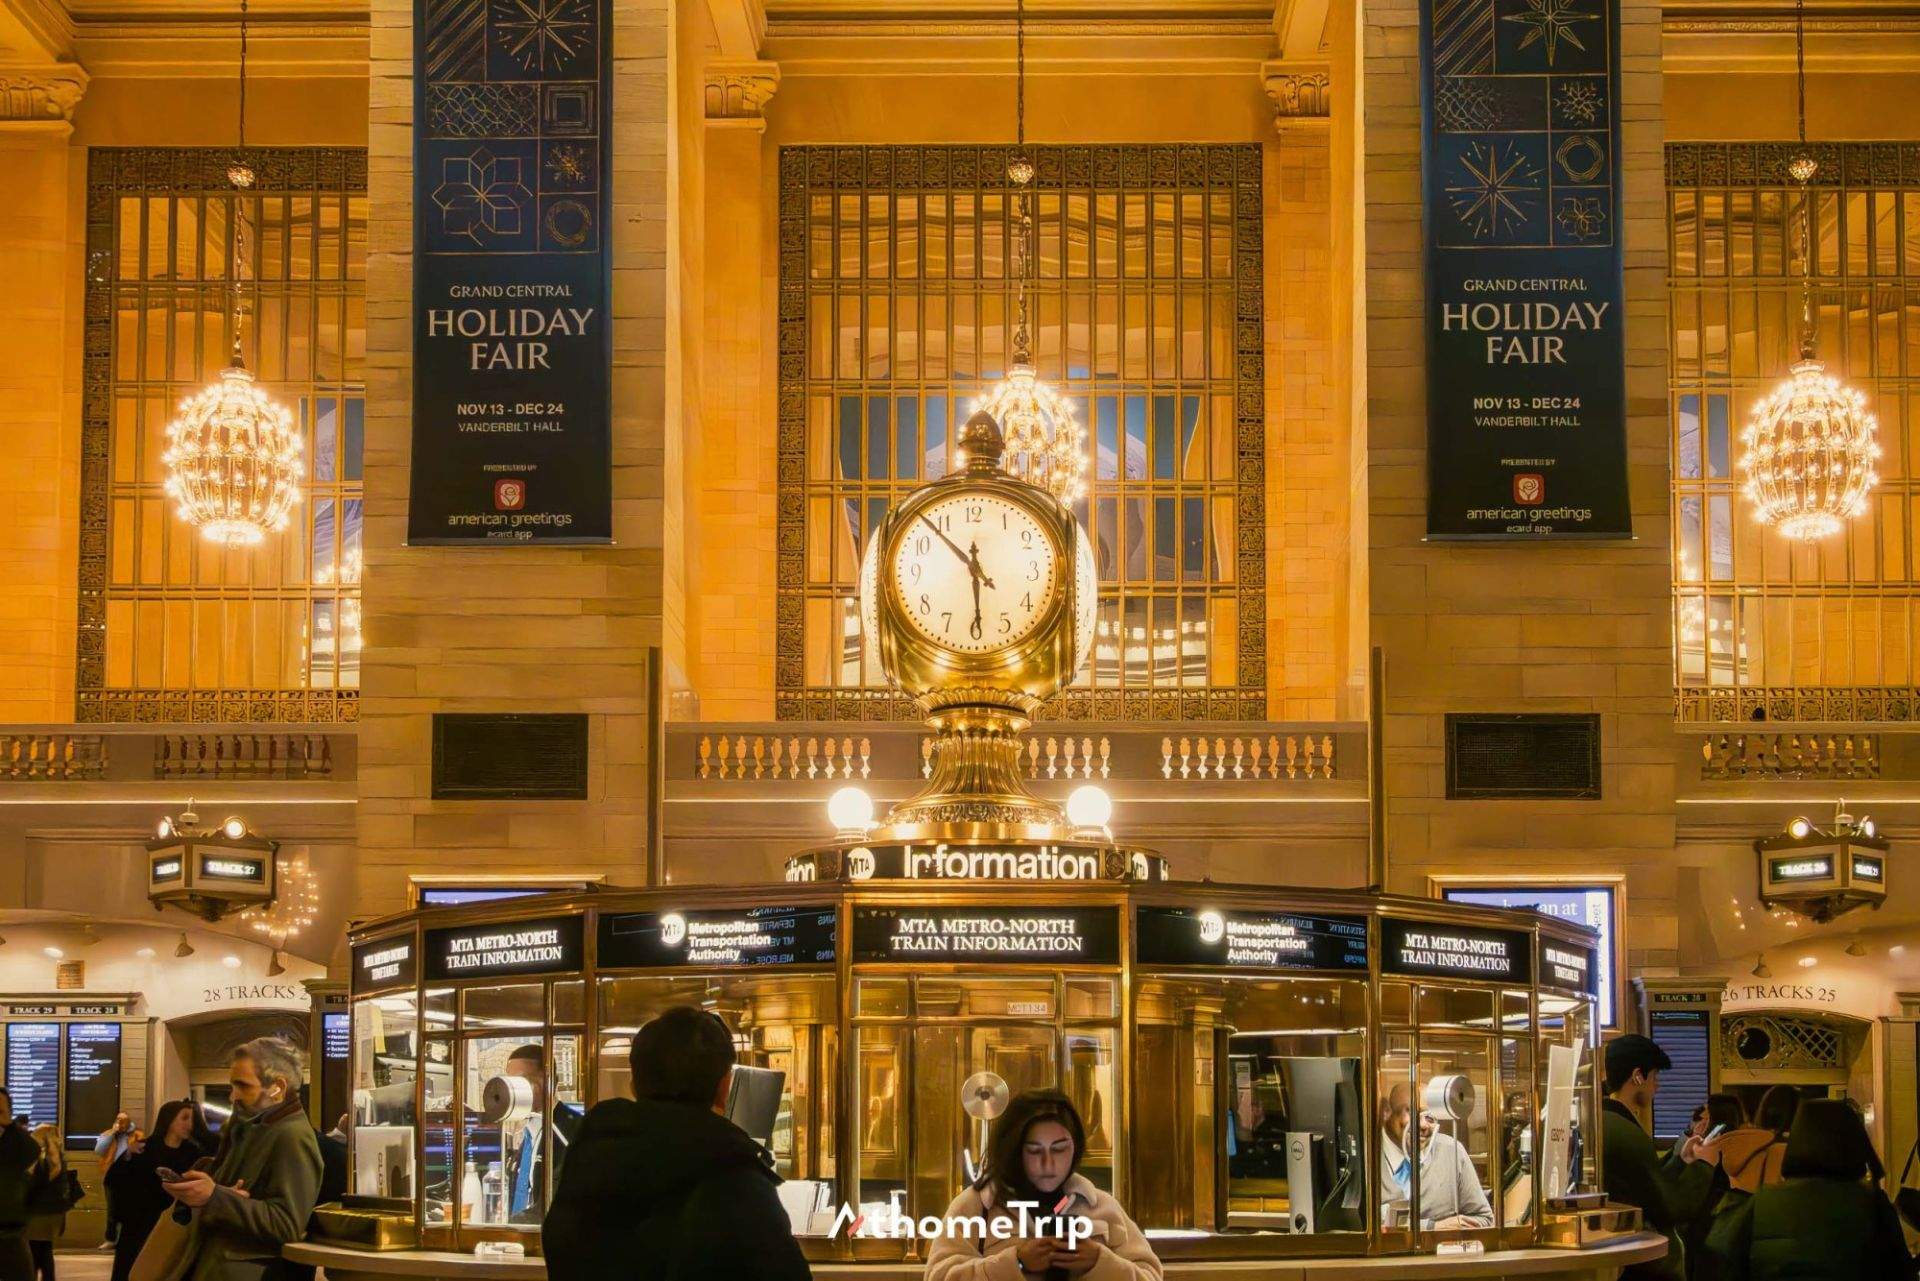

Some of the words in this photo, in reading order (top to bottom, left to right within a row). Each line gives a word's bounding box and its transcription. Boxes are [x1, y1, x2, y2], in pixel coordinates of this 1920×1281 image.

[450, 286, 503, 298] GRAND
[506, 285, 572, 297] CENTRAL
[1464, 279, 1516, 291] GRAND
[1520, 279, 1587, 291] CENTRAL
[427, 308, 594, 337] HOLIDAY
[1442, 302, 1609, 331] HOLIDAY
[470, 342, 551, 370] FAIR
[1486, 336, 1567, 363] FAIR
[457, 404, 487, 415] NOV
[491, 404, 504, 414] 13
[516, 403, 544, 414] DEC
[547, 403, 565, 414] 24
[1474, 398, 1503, 409] NOV
[1507, 398, 1521, 409] 13
[1532, 398, 1561, 409] DEC
[1564, 398, 1580, 408] 24
[458, 422, 530, 432] VANDERBILT
[533, 421, 563, 432] HALL
[1474, 416, 1548, 427] VANDERBILT
[1550, 416, 1580, 426] HALL
[448, 512, 508, 525] american
[511, 511, 572, 527] greetings
[965, 506, 982, 523] 12
[1002, 513, 1007, 530] 1
[1466, 507, 1527, 519] american
[1529, 506, 1592, 521] greetings
[1534, 525, 1552, 535] app
[916, 535, 930, 556] 10
[1021, 530, 1032, 550] 2
[910, 564, 921, 586] 9
[1026, 560, 1039, 581] 3
[919, 593, 931, 615] 8
[1020, 591, 1034, 612] 4
[941, 612, 952, 633] 7
[970, 618, 982, 640] 6
[999, 612, 1011, 634] 5
[904, 844, 1098, 880] Information
[1562, 902, 1579, 915] at
[688, 921, 759, 936] Metropolitan
[899, 919, 938, 933] MTA
[942, 919, 1075, 933] METRO-NORTH
[1226, 921, 1295, 936] Metropolitan
[450, 938, 475, 953] MTA
[475, 930, 557, 950] METRO-NORTH
[688, 934, 771, 948] Transportation
[890, 936, 948, 950] TRAIN
[953, 936, 1082, 950] INFORMATION
[1226, 935, 1307, 949] Transportation
[1405, 933, 1429, 949] MTA
[1430, 936, 1506, 955] METRO-NORTH
[446, 953, 480, 968] TRAIN
[482, 946, 562, 966] INFORMATION
[688, 947, 740, 961] Authority
[1227, 948, 1278, 963] Authority
[1401, 949, 1435, 965] TRAIN
[1438, 953, 1510, 972] INFORMATION
[203, 988, 221, 1002] 28
[225, 984, 295, 1000] TRACKS
[1721, 988, 1739, 1002] 26
[1743, 985, 1813, 1000] TRACKS
[1818, 988, 1837, 1002] 25
[14, 1006, 40, 1014] TRACK
[76, 1006, 101, 1014] TRACK
